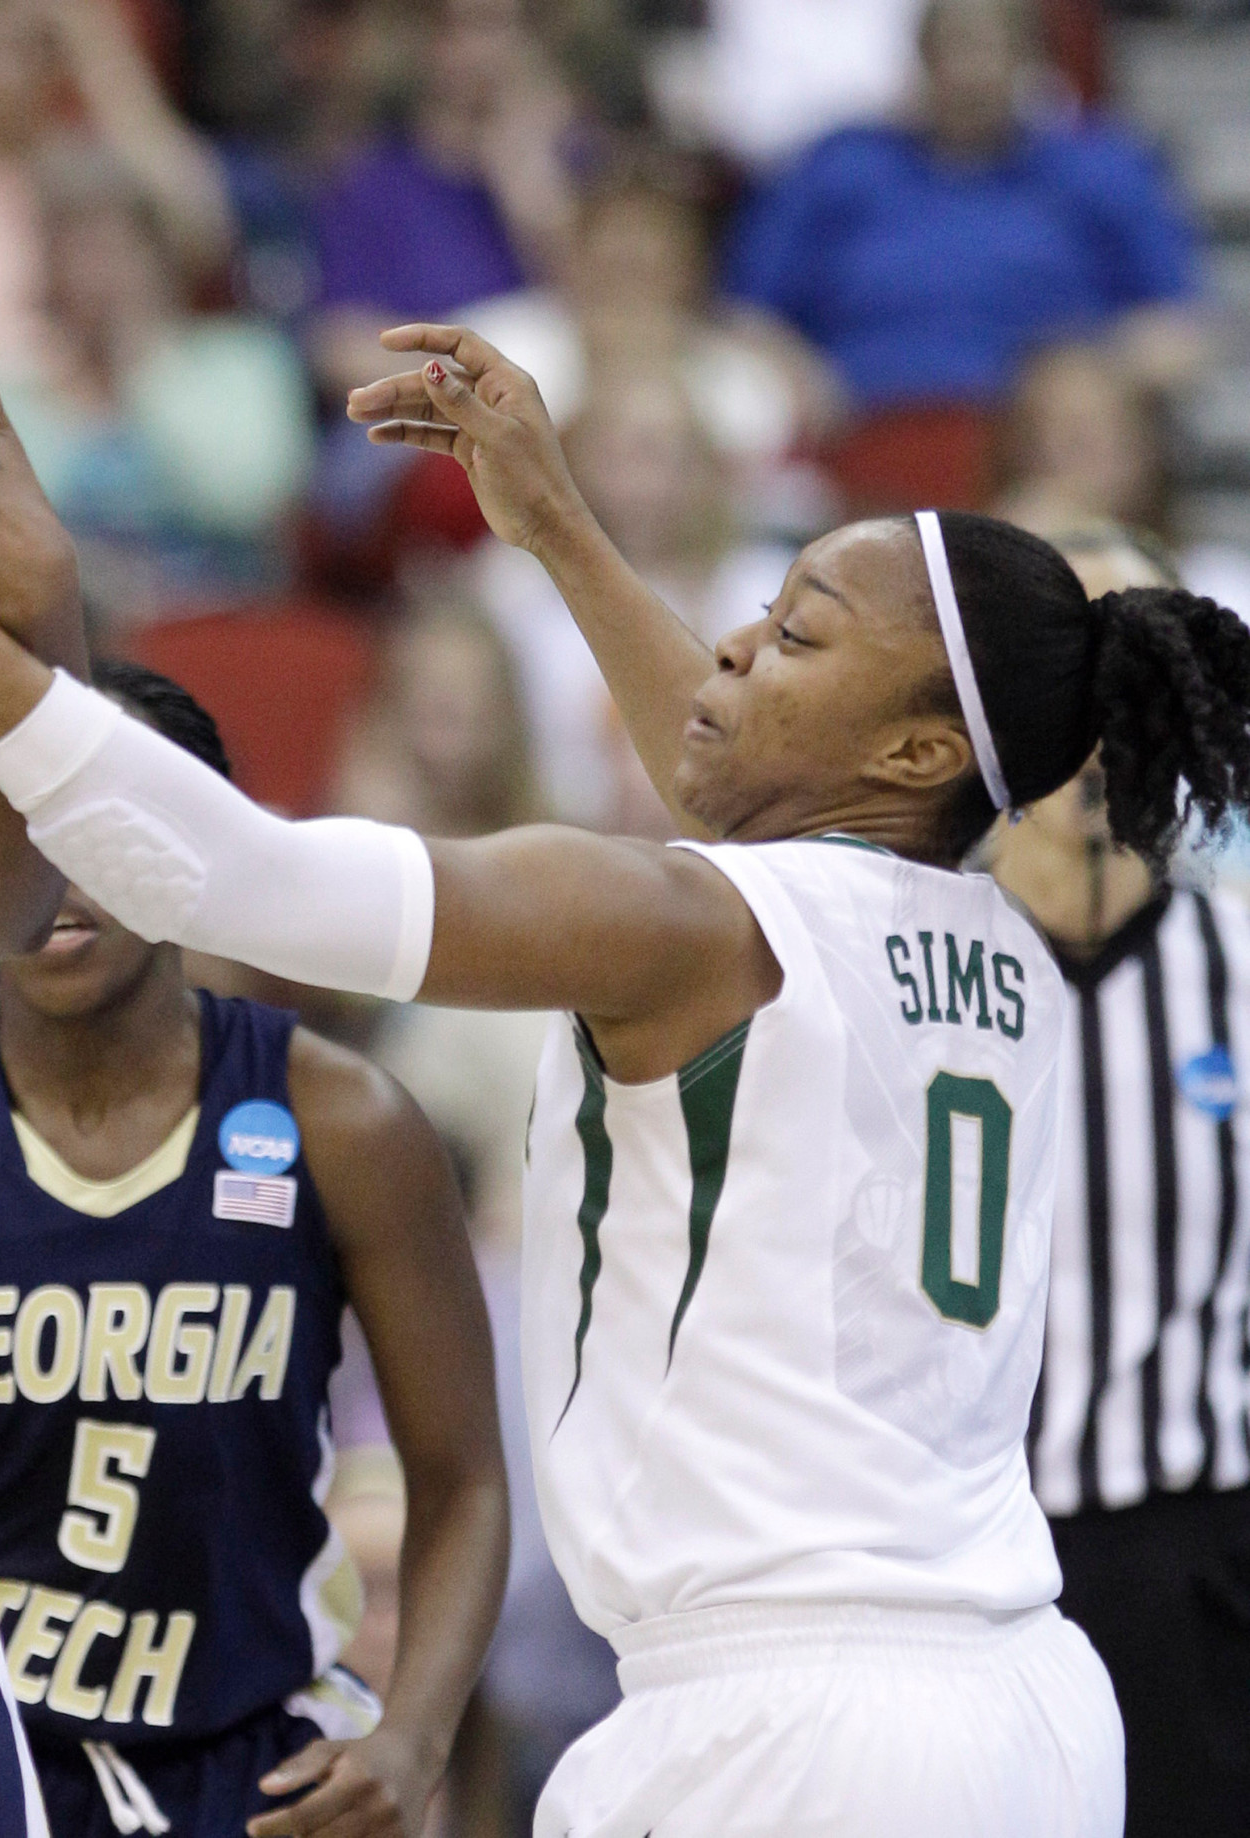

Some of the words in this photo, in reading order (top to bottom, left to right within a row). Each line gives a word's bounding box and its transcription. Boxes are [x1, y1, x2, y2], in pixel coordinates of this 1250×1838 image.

[885, 930, 1026, 1042] SIMS
[917, 1065, 1014, 1335] 0
[58, 1418, 156, 1574] 5
